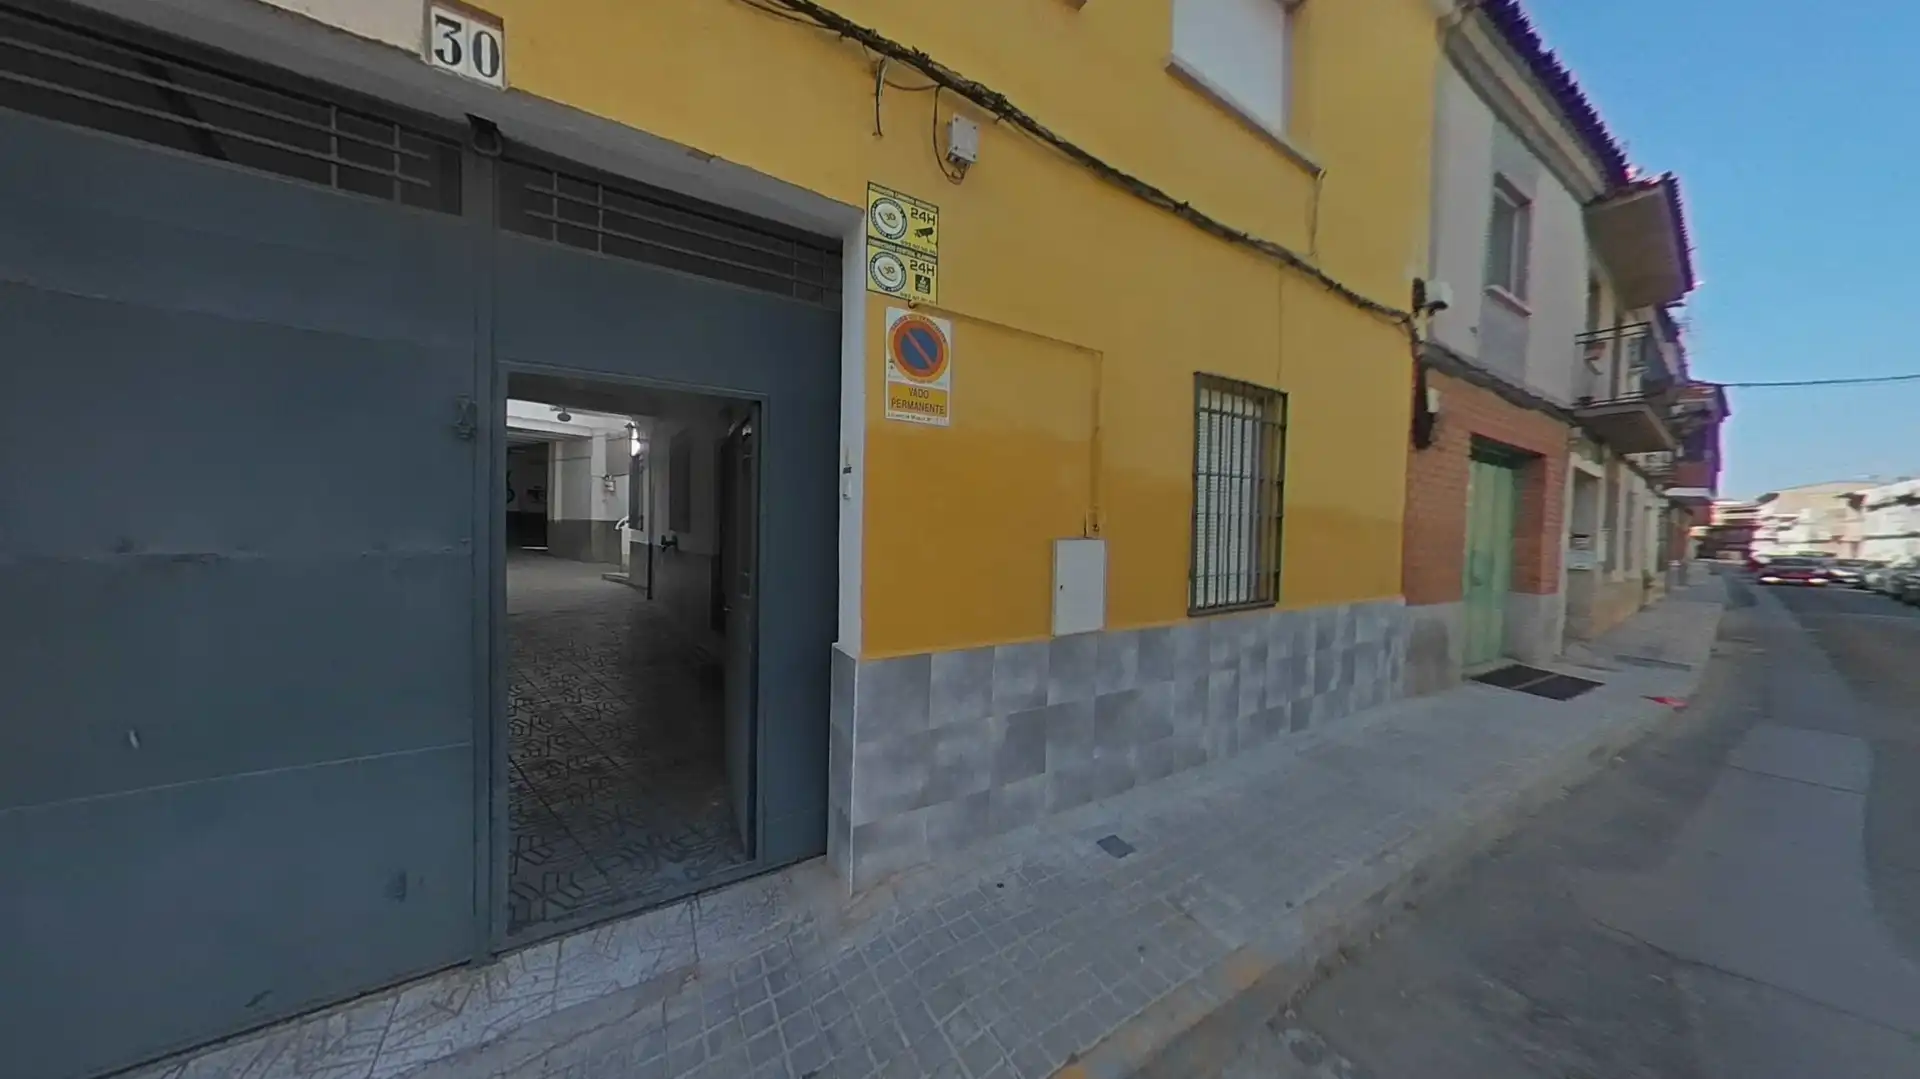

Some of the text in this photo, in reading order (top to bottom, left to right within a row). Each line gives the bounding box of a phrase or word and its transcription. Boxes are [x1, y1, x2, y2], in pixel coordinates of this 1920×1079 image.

[434, 14, 500, 78] 30
[910, 207, 936, 226] 24H
[909, 259, 935, 277] 24H
[908, 387, 930, 400] VADO
[891, 398, 946, 416] PERMANENTE
